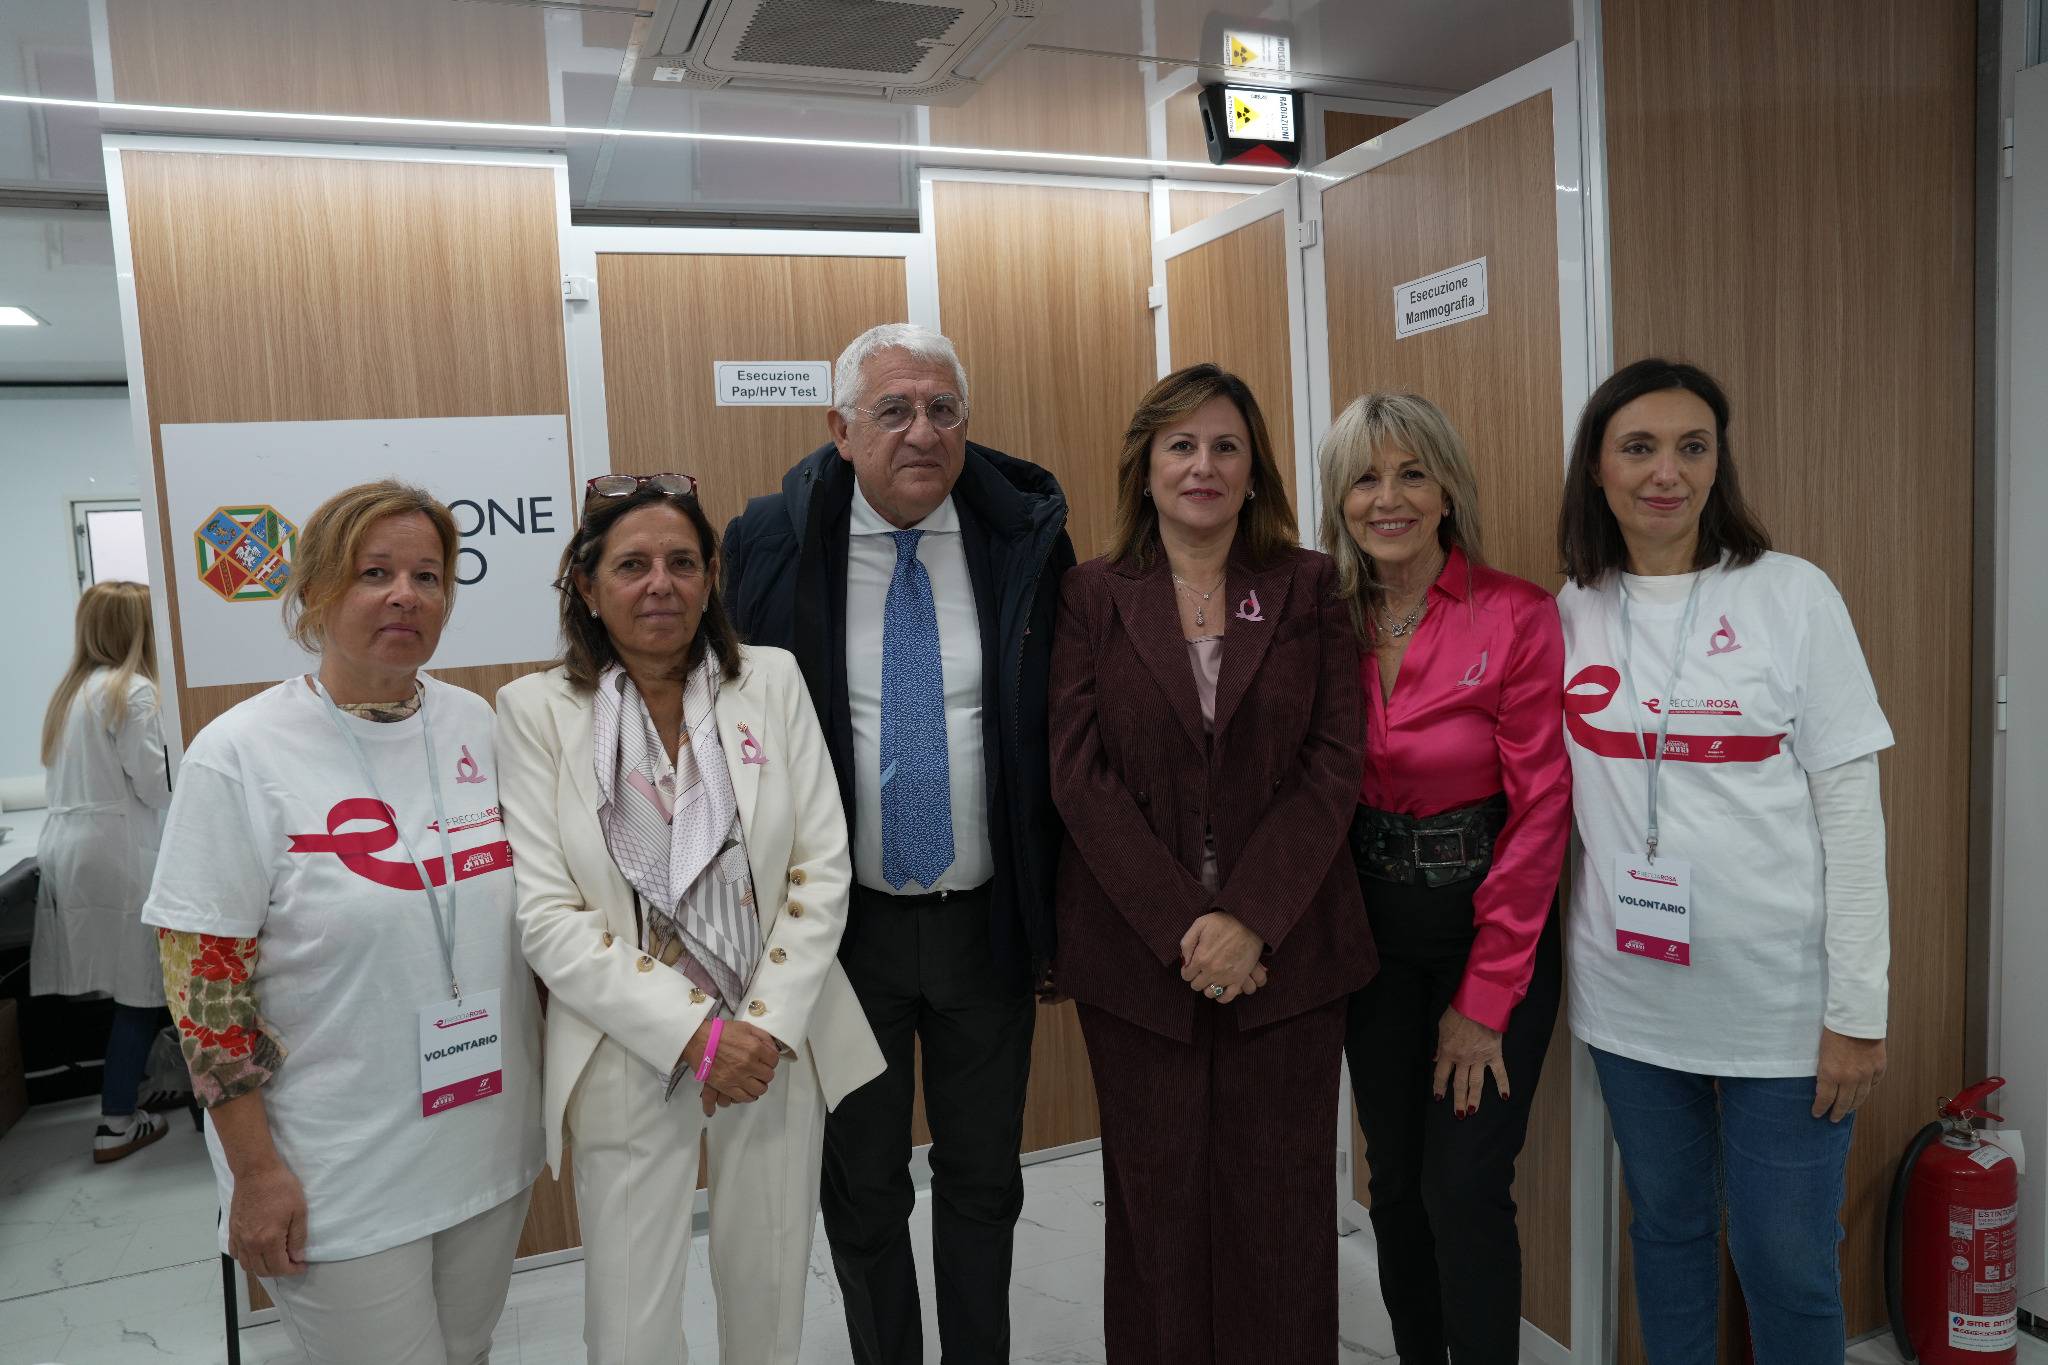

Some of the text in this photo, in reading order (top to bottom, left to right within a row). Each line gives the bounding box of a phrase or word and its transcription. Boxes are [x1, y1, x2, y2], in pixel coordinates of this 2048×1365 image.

[1227, 95, 1235, 133] ATTENZIONE
[1279, 96, 1290, 140] RADIAZIONI
[1410, 277, 1468, 304] Esecuzione
[1405, 295, 1475, 325] Mammografia
[737, 370, 810, 381] Esecuzione
[732, 386, 817, 399] Pap/HPV Test
[1669, 698, 1739, 709] RECCIAROSA
[445, 806, 500, 826] FRECCIARO
[1617, 894, 1686, 915] VOLONTARIO
[424, 1034, 498, 1062] VOLONTARIO
